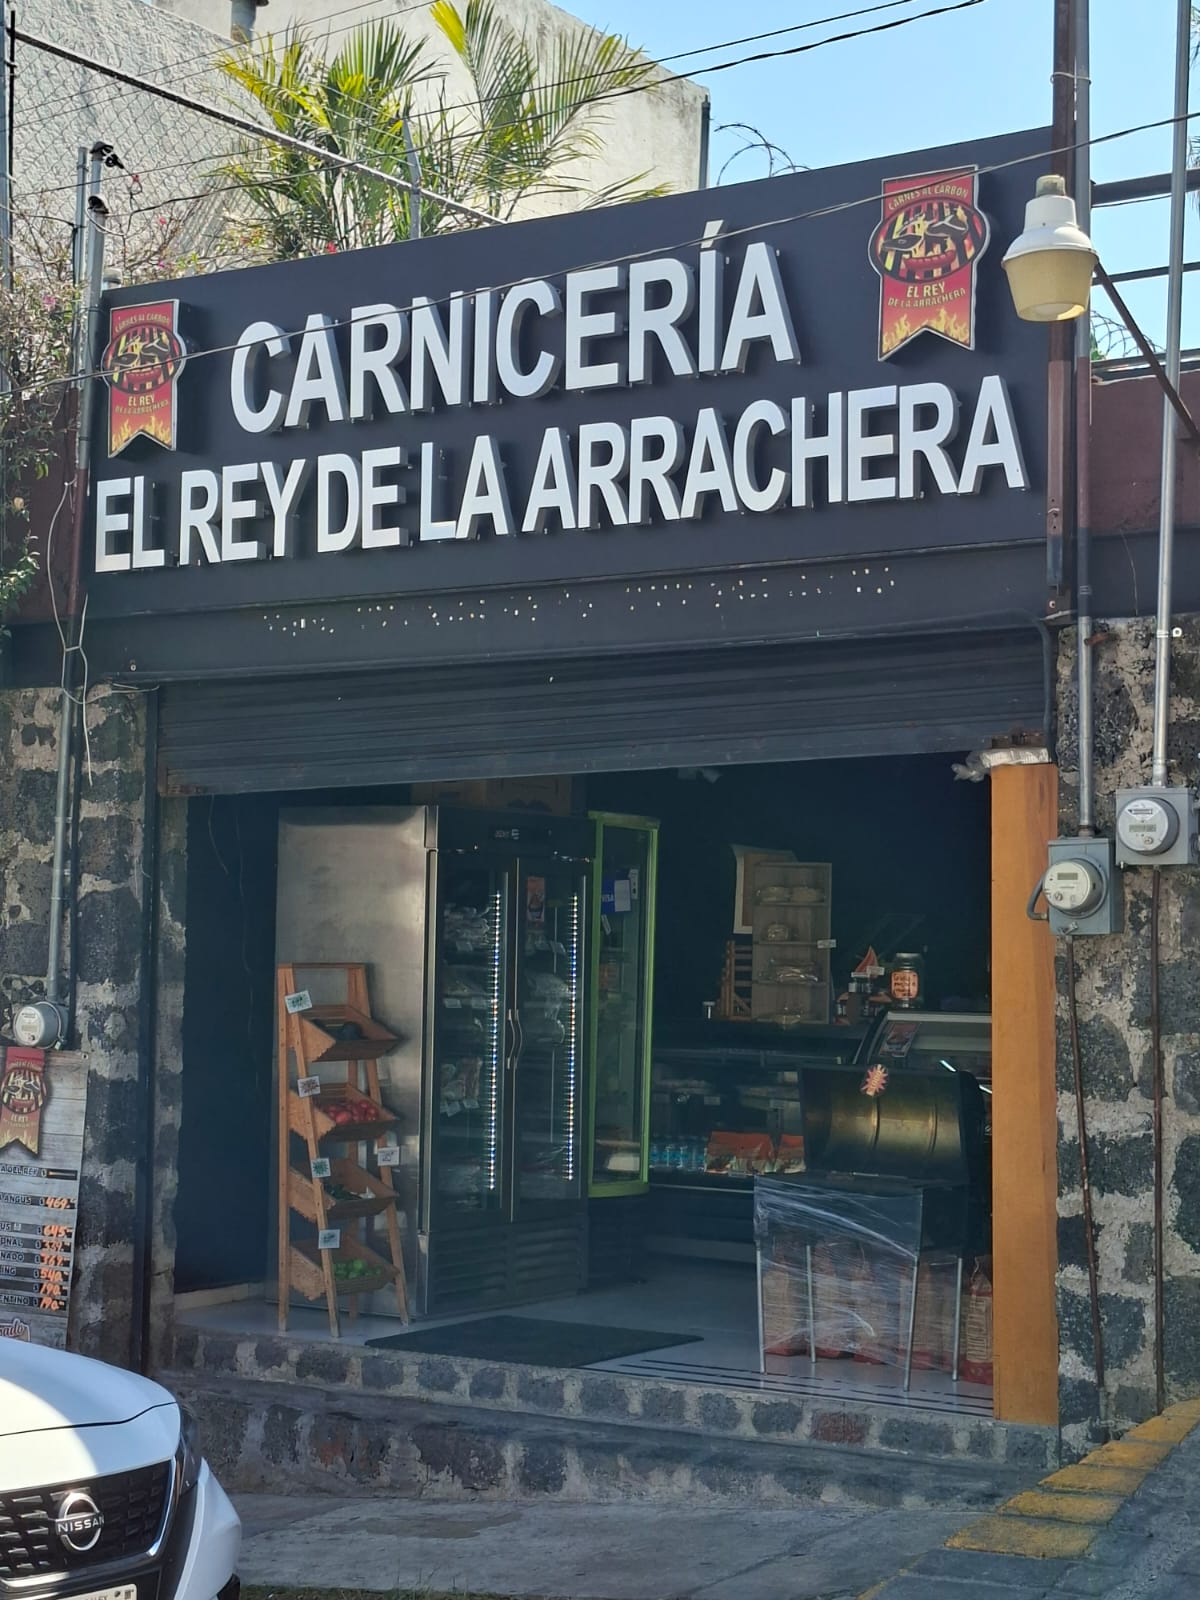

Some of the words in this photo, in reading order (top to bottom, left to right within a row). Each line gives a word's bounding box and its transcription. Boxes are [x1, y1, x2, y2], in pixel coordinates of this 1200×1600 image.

[888, 190, 920, 210] CARNES
[922, 186, 932, 195] AL
[934, 184, 969, 199] CARBON
[888, 298, 899, 307] DE
[913, 287, 967, 308] ARRACHERA
[907, 286, 920, 298] EL
[923, 281, 946, 297] REY
[230, 219, 796, 434] CARNICERÍA
[128, 395, 137, 407] EL
[139, 394, 155, 406] REY
[95, 475, 166, 573] EL
[179, 458, 305, 566] REY
[317, 446, 405, 553] DE
[420, 434, 510, 542] LA
[521, 374, 1026, 532] ARRACHERA
[3, 1193, 31, 1205] ANGUS
[57, 1516, 104, 1532] NISSAN
